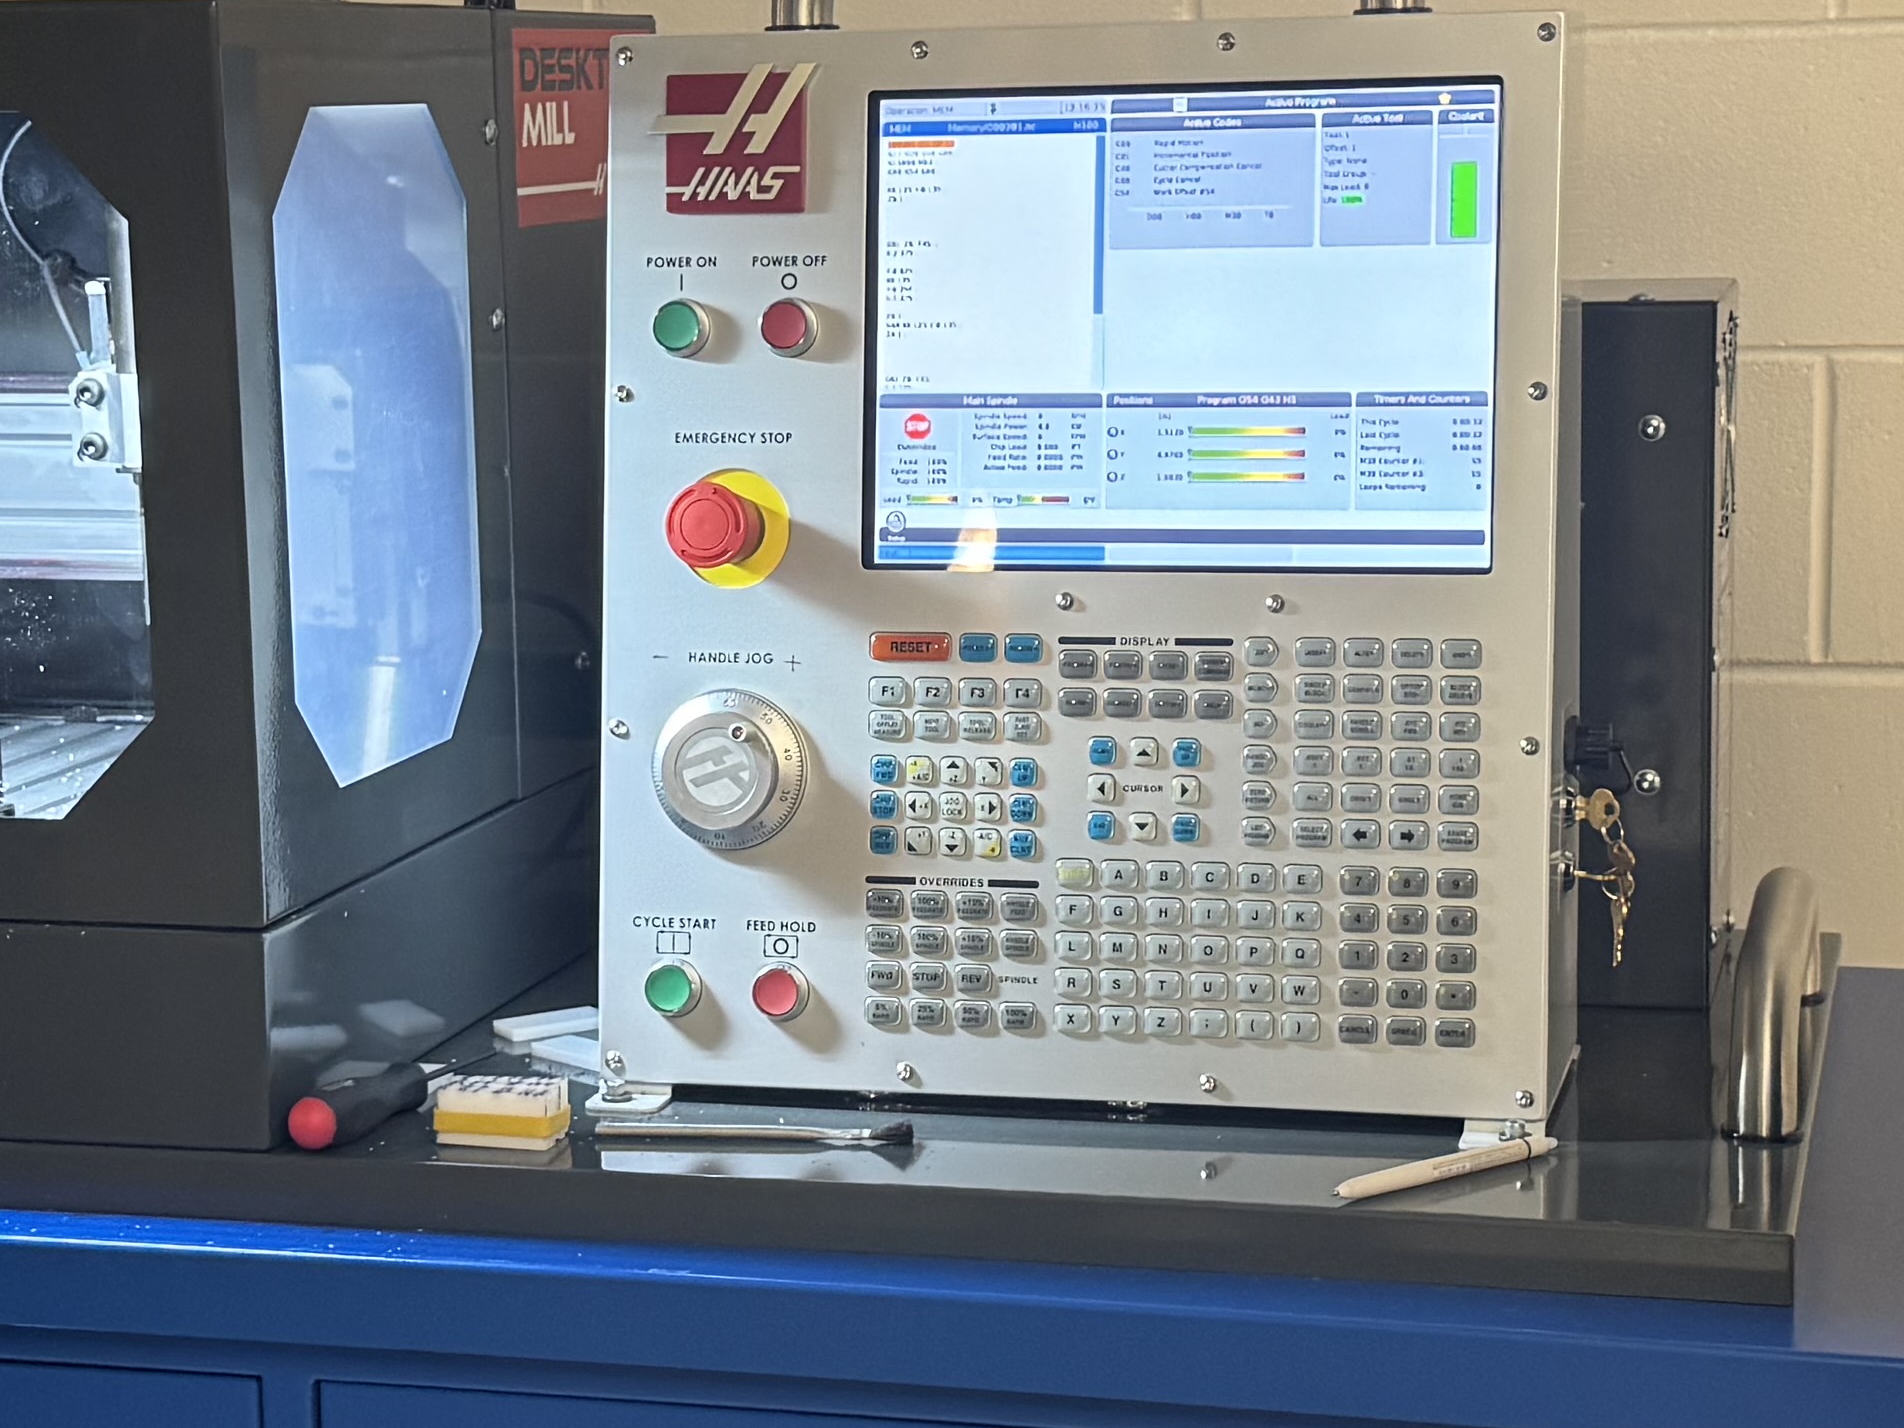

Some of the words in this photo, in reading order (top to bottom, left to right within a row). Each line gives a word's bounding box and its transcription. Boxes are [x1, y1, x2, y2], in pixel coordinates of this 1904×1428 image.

[518, 47, 609, 92] DESKT
[1295, 98, 1336, 108] Program
[522, 101, 575, 147] MILL
[665, 166, 800, 201] HAAS
[647, 257, 692, 268] POWER
[696, 256, 717, 267] ON
[752, 256, 798, 267] POWER
[803, 255, 827, 266] OFF
[1197, 396, 1236, 405] Program
[1407, 395, 1426, 404] And
[1428, 395, 1470, 403] Counters
[675, 432, 756, 444] EMERGENCY
[761, 433, 792, 443] STOP
[1120, 637, 1169, 646] DISPLAY
[890, 642, 932, 653] RESET
[689, 652, 741, 664] HANDLE
[744, 653, 773, 664] JOG
[882, 686, 895, 696] F1
[926, 687, 940, 697] F2
[971, 688, 985, 698] F3
[1016, 689, 1029, 698] F4
[784, 748, 792, 761] 40
[942, 808, 962, 816] LOCK
[1115, 870, 1122, 880] A
[1160, 871, 1168, 881] B
[1206, 872, 1214, 882] C
[1252, 874, 1259, 883] D
[1298, 875, 1305, 885] E
[920, 877, 984, 887] OVERRIDES
[1355, 877, 1362, 886] 7
[1404, 879, 1410, 888] 8
[1453, 880, 1459, 889] 9
[1070, 905, 1076, 914] F
[1114, 906, 1122, 916] G
[1160, 908, 1167, 918] H
[1252, 910, 1258, 920] J
[1297, 912, 1304, 922] K
[1354, 914, 1361, 923] 4
[633, 916, 676, 928] CYCLE
[679, 918, 716, 930] START
[1403, 916, 1410, 925] 5
[1452, 917, 1459, 926] 6
[747, 920, 777, 933] FEED
[781, 920, 816, 933] HOLD
[1069, 941, 1075, 951] L
[1113, 943, 1122, 953] M
[1159, 944, 1167, 954] N
[1204, 946, 1213, 955] O
[1250, 947, 1257, 957] P
[1296, 949, 1304, 959] Q
[1402, 953, 1409, 962] 2
[1451, 955, 1458, 964] 3
[913, 973, 940, 982] STOP
[961, 974, 982, 983] REV
[998, 976, 1038, 984] SPINDLE
[1067, 978, 1075, 987] R
[1113, 980, 1120, 989] S
[1159, 981, 1166, 991] T
[1204, 983, 1211, 992] U
[1250, 984, 1257, 994] V
[1293, 986, 1305, 996] W
[1067, 1014, 1074, 1024] X
[1112, 1016, 1120, 1026] Y
[1157, 1017, 1165, 1027] Z
